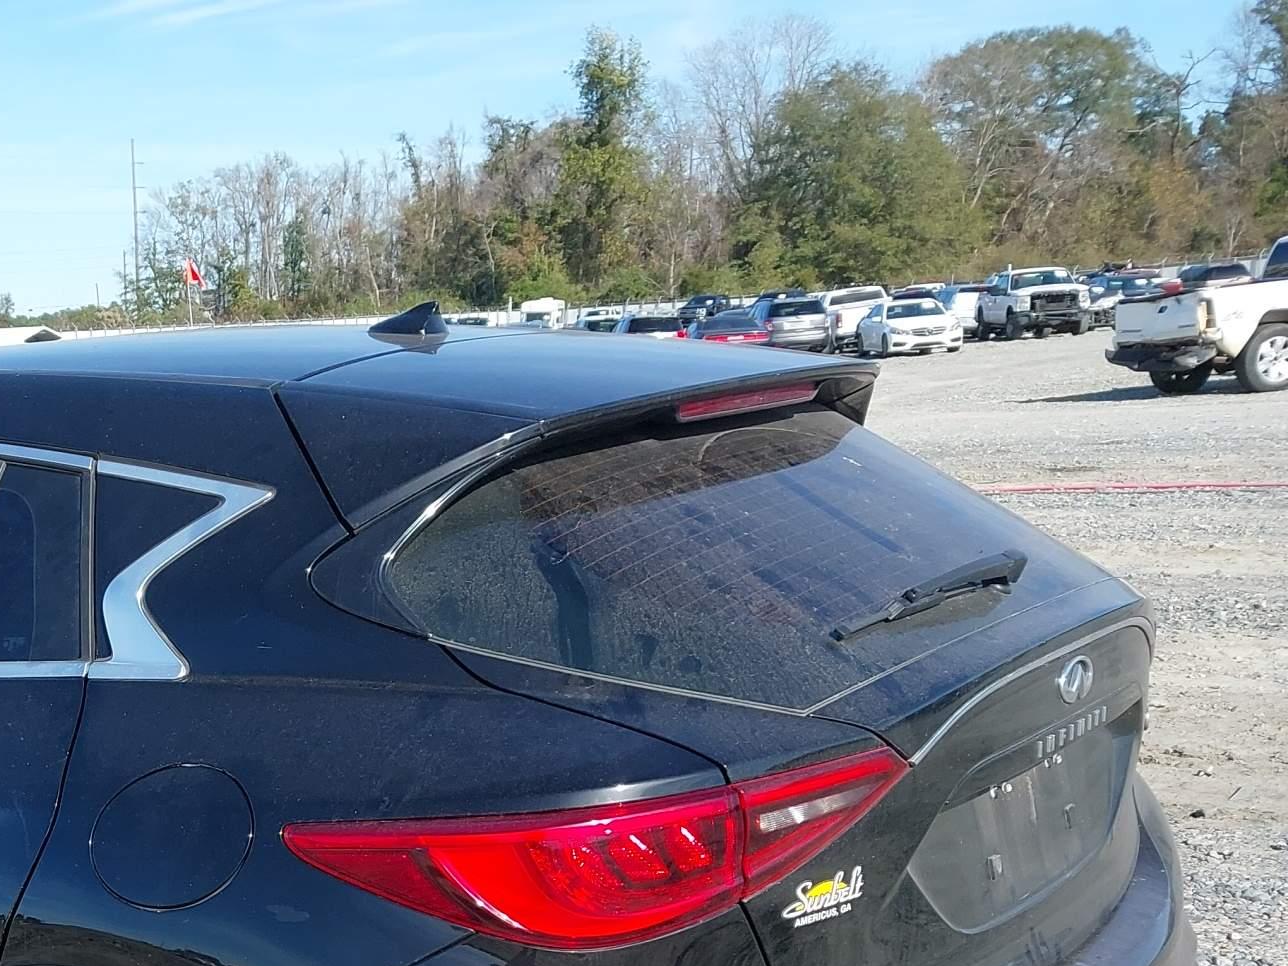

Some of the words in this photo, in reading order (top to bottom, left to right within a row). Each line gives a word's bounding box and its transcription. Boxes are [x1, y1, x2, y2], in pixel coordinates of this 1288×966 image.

[1037, 705, 1107, 758] INFINITI
[782, 865, 864, 919] Sunbelt
[794, 907, 839, 928] AMERICUS,
[840, 903, 851, 913] GA
